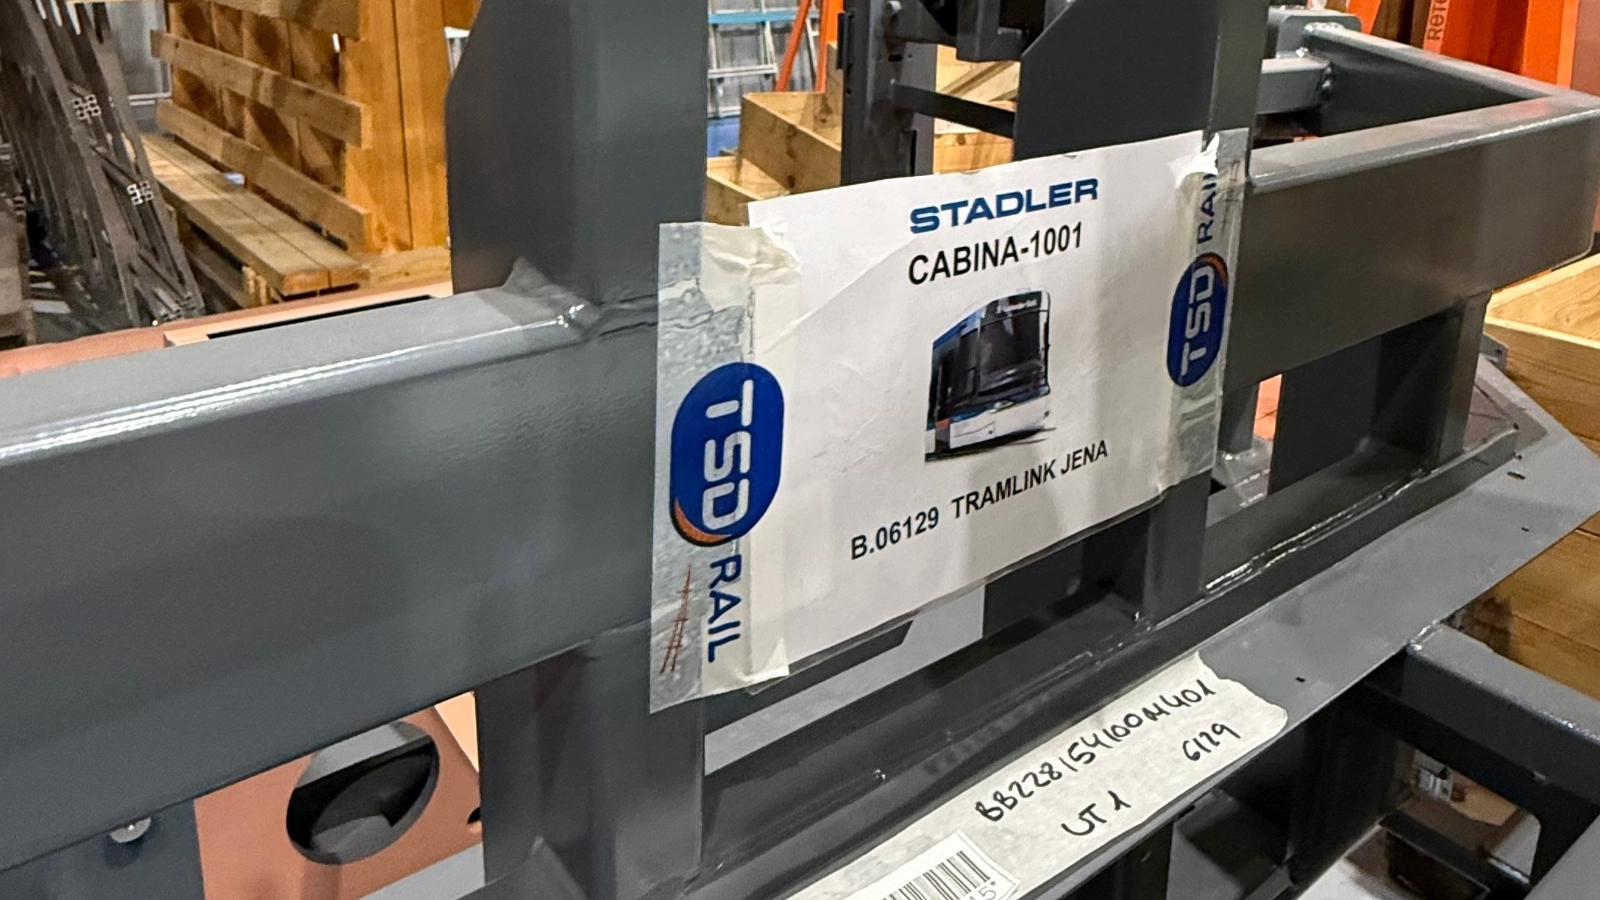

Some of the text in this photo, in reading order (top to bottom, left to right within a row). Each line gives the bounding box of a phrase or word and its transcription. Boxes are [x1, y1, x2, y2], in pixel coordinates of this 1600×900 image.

[1426, 0, 1447, 40] Ret
[910, 178, 1098, 234] STADLER
[909, 222, 1082, 285] CABINA-1001
[1181, 265, 1215, 376] TSD
[702, 379, 754, 530] TSD
[851, 440, 1108, 560] B.06129 TRAMLINK JENA
[708, 554, 741, 663] RAIL
[1181, 723, 1241, 761] 6129
